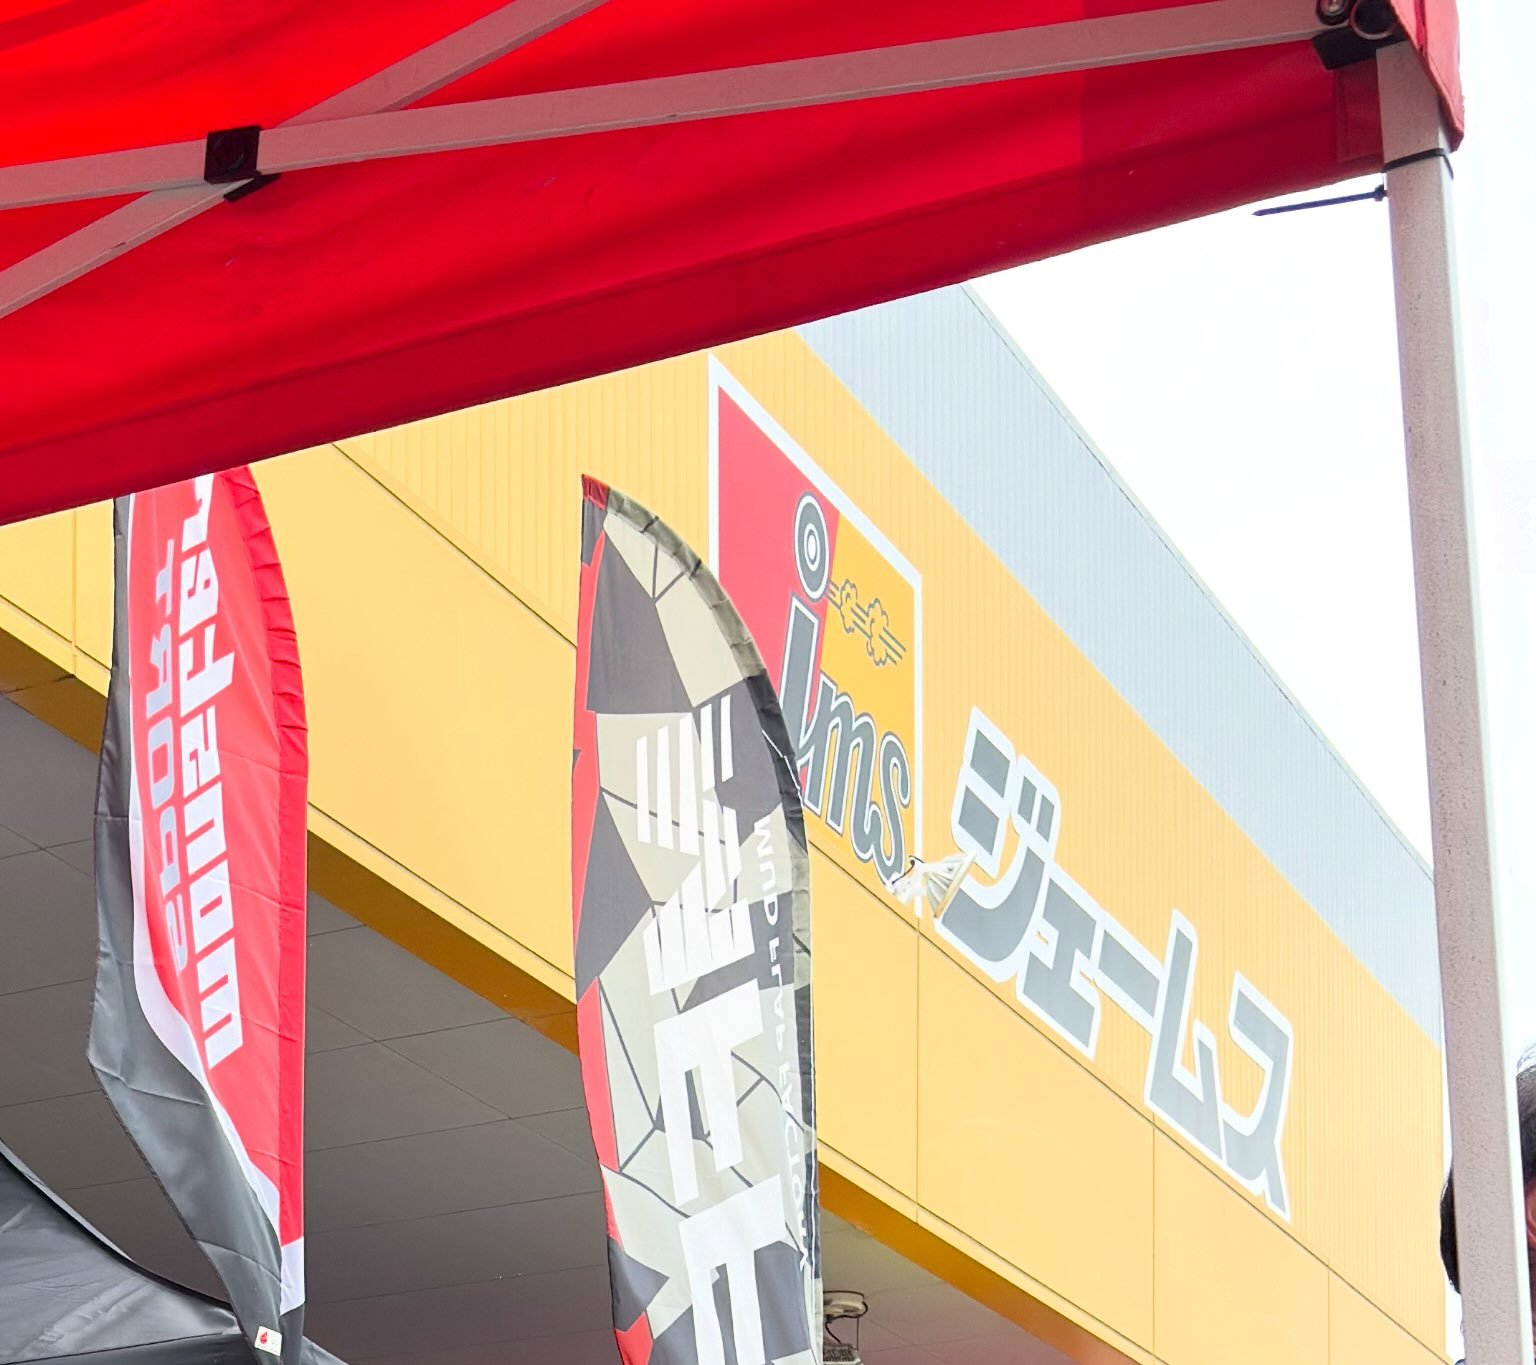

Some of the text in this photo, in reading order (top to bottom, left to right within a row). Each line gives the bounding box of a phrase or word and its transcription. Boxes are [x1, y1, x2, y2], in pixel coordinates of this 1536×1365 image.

[936, 707, 1294, 1222] ジェームス
